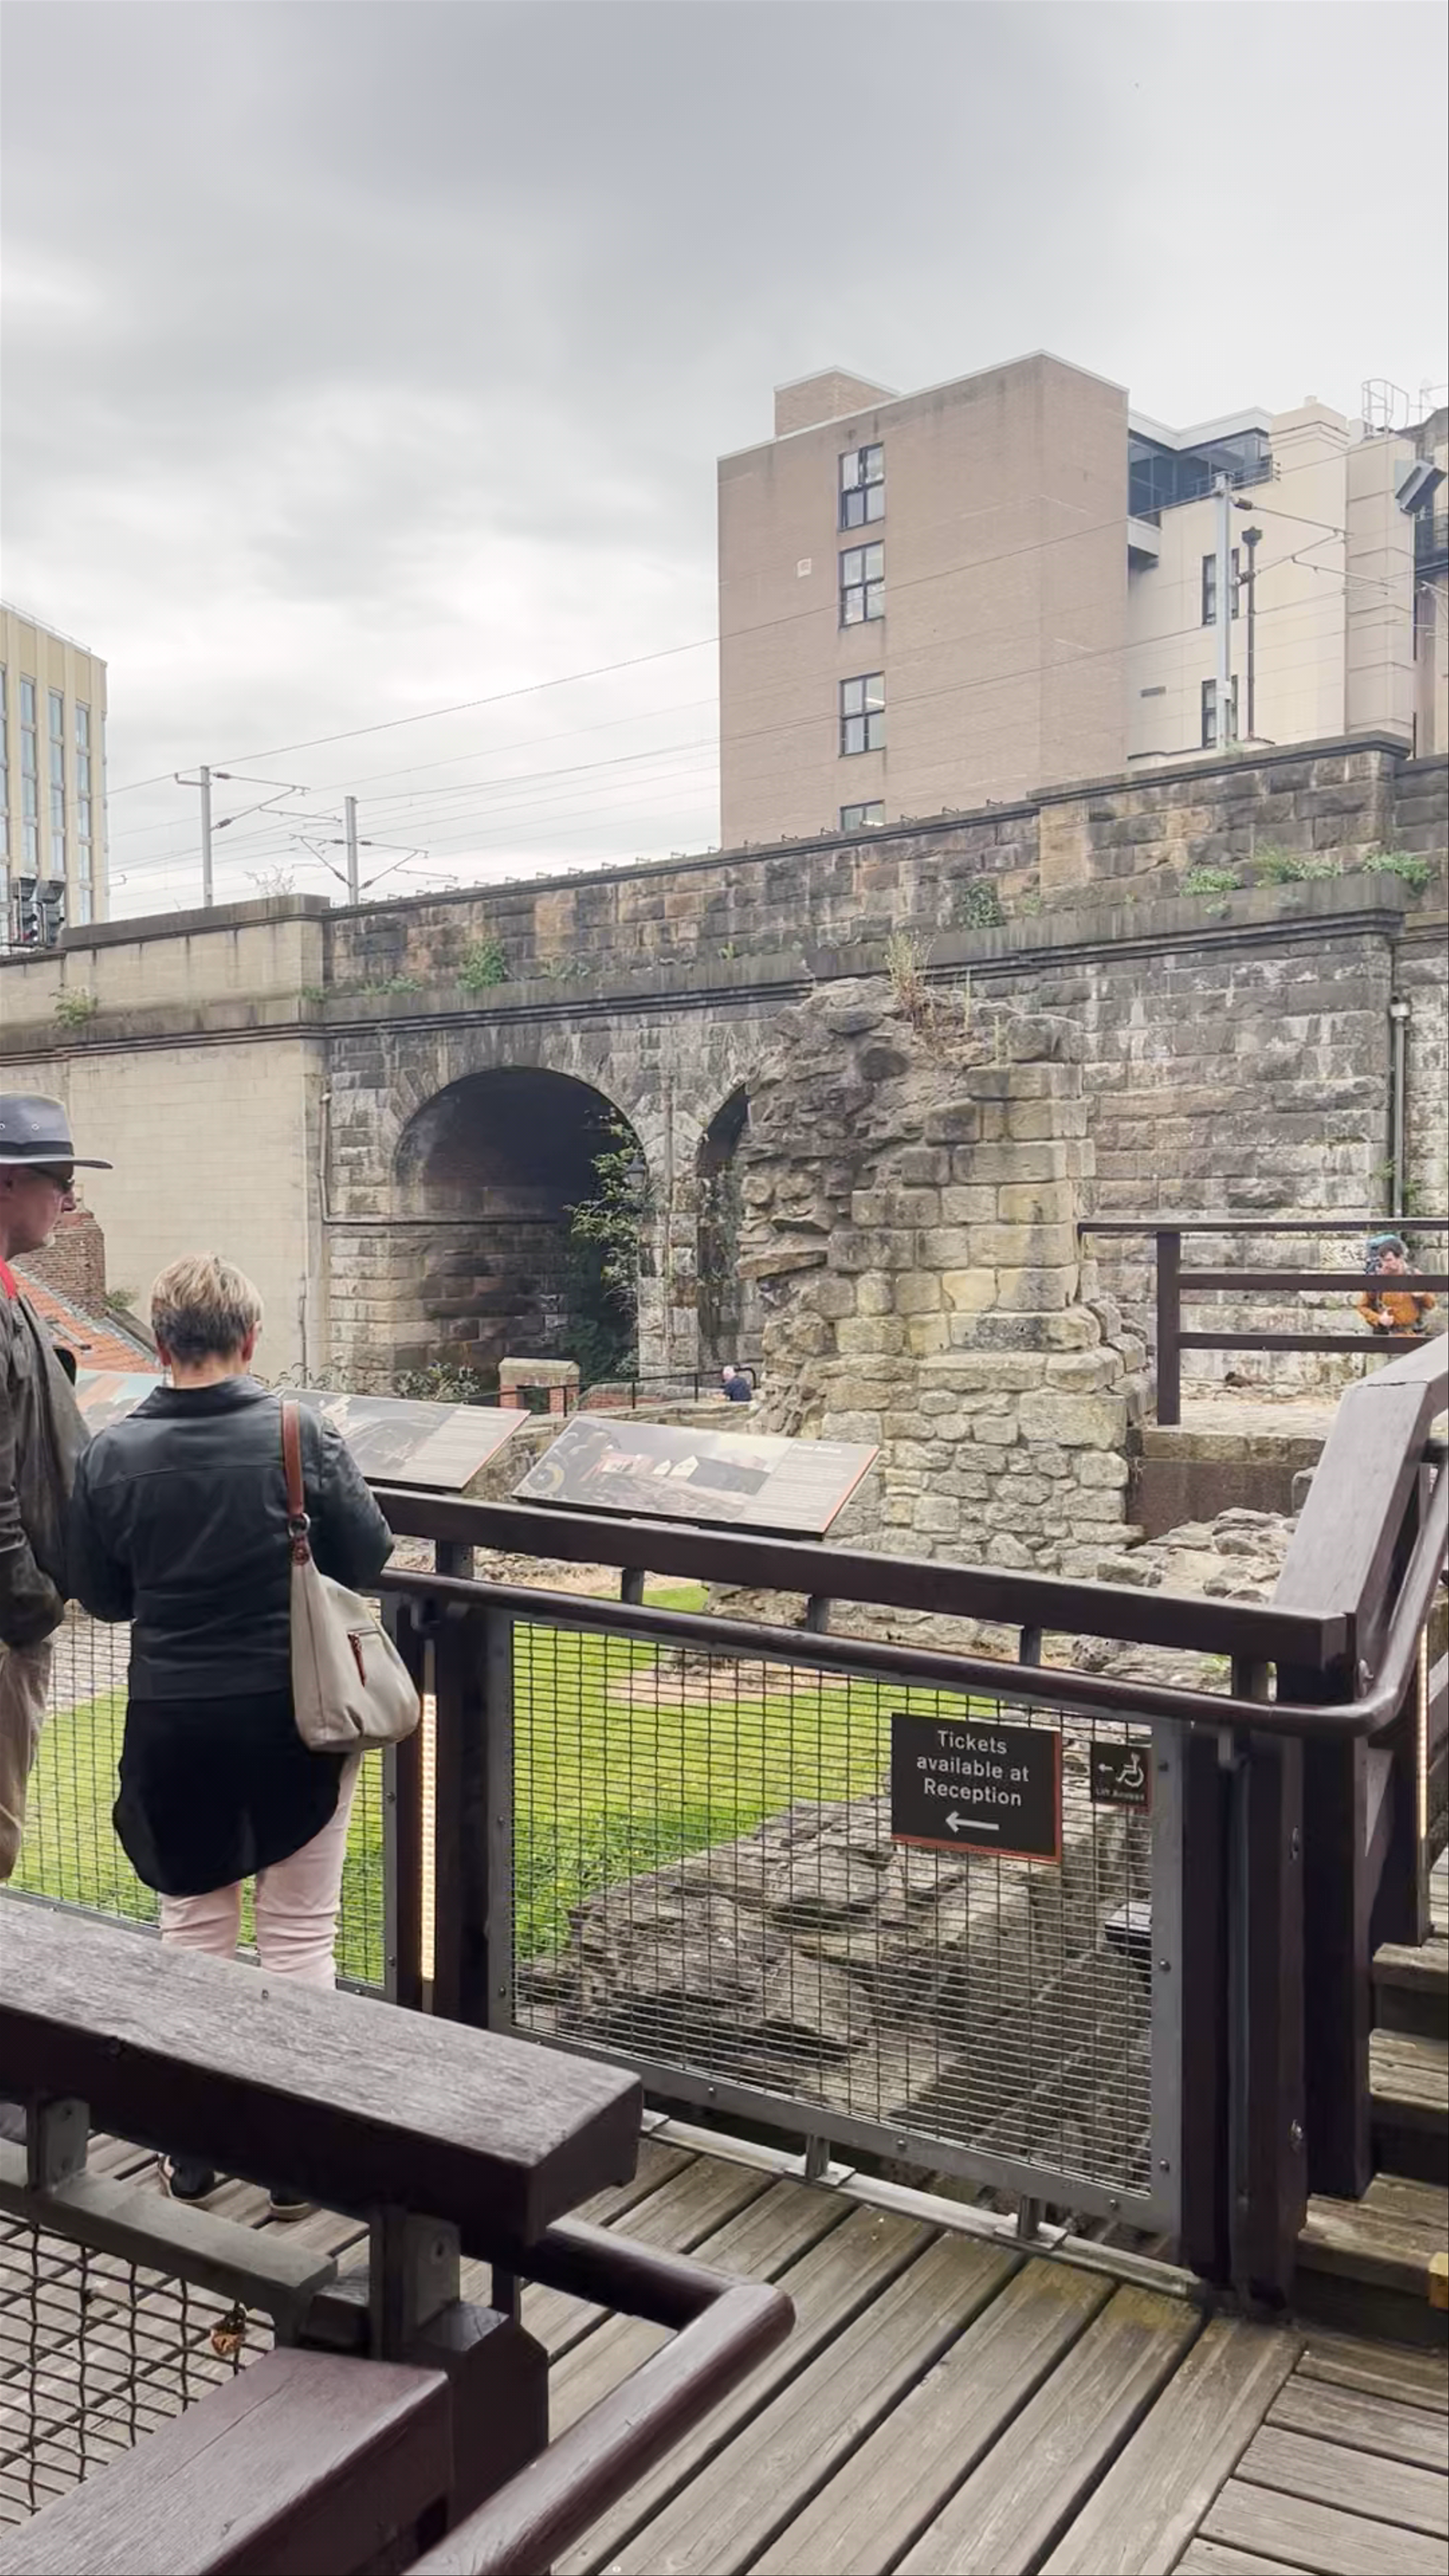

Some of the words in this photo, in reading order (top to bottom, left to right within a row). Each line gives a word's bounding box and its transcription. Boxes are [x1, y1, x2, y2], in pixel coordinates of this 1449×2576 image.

[937, 1730, 1007, 1754] Tickets
[917, 1756, 1003, 1779] available
[1010, 1767, 1029, 1782] at
[924, 1777, 1021, 1806] Reception
